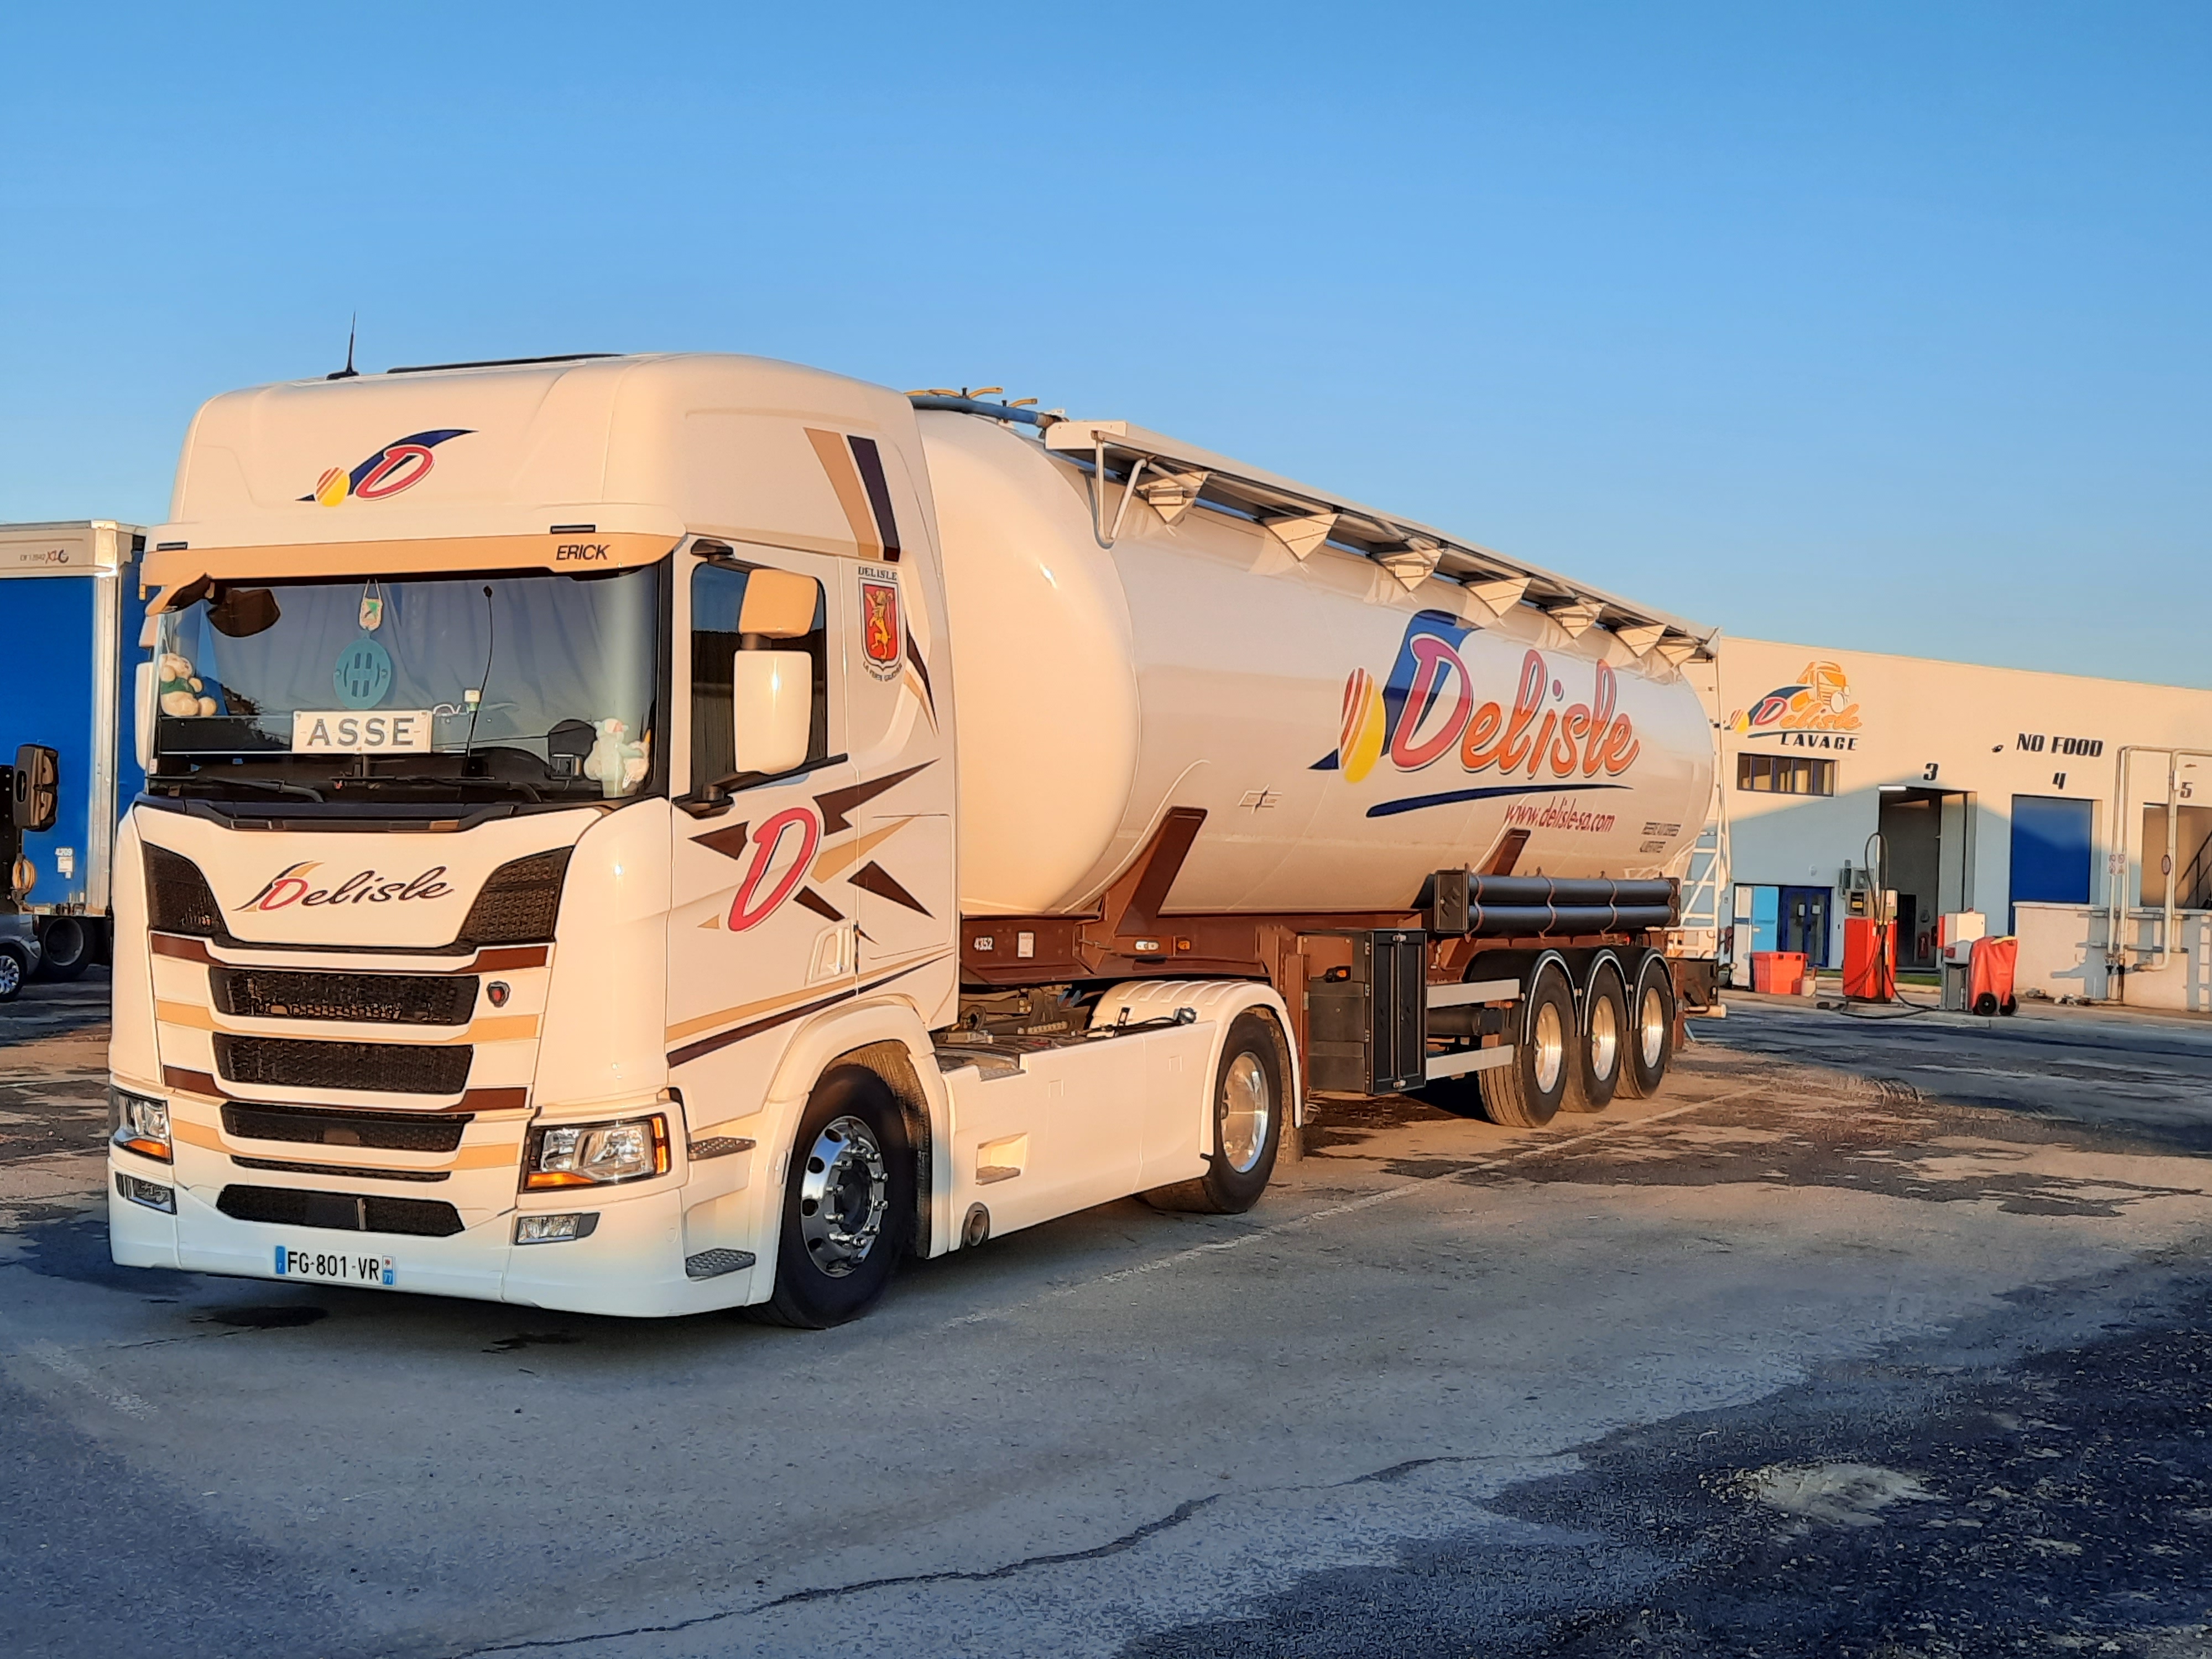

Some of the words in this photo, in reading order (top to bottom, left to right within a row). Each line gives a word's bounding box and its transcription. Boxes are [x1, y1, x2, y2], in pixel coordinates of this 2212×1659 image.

[556, 544, 611, 560] ERICK
[858, 566, 897, 580] DELISLE
[1390, 634, 1640, 780] Delisle
[1754, 697, 1863, 730] Delisle
[306, 717, 414, 747] ASSE
[1781, 733, 1858, 751] LAVAGE
[2016, 733, 2045, 752] NO
[2051, 737, 2103, 757] FOOD
[1923, 763, 1939, 781] 3
[2053, 773, 2066, 789] 4
[2180, 781, 2193, 798] 5
[1504, 796, 1615, 832] www.delisle-sa.com
[259, 866, 455, 911] Delisle
